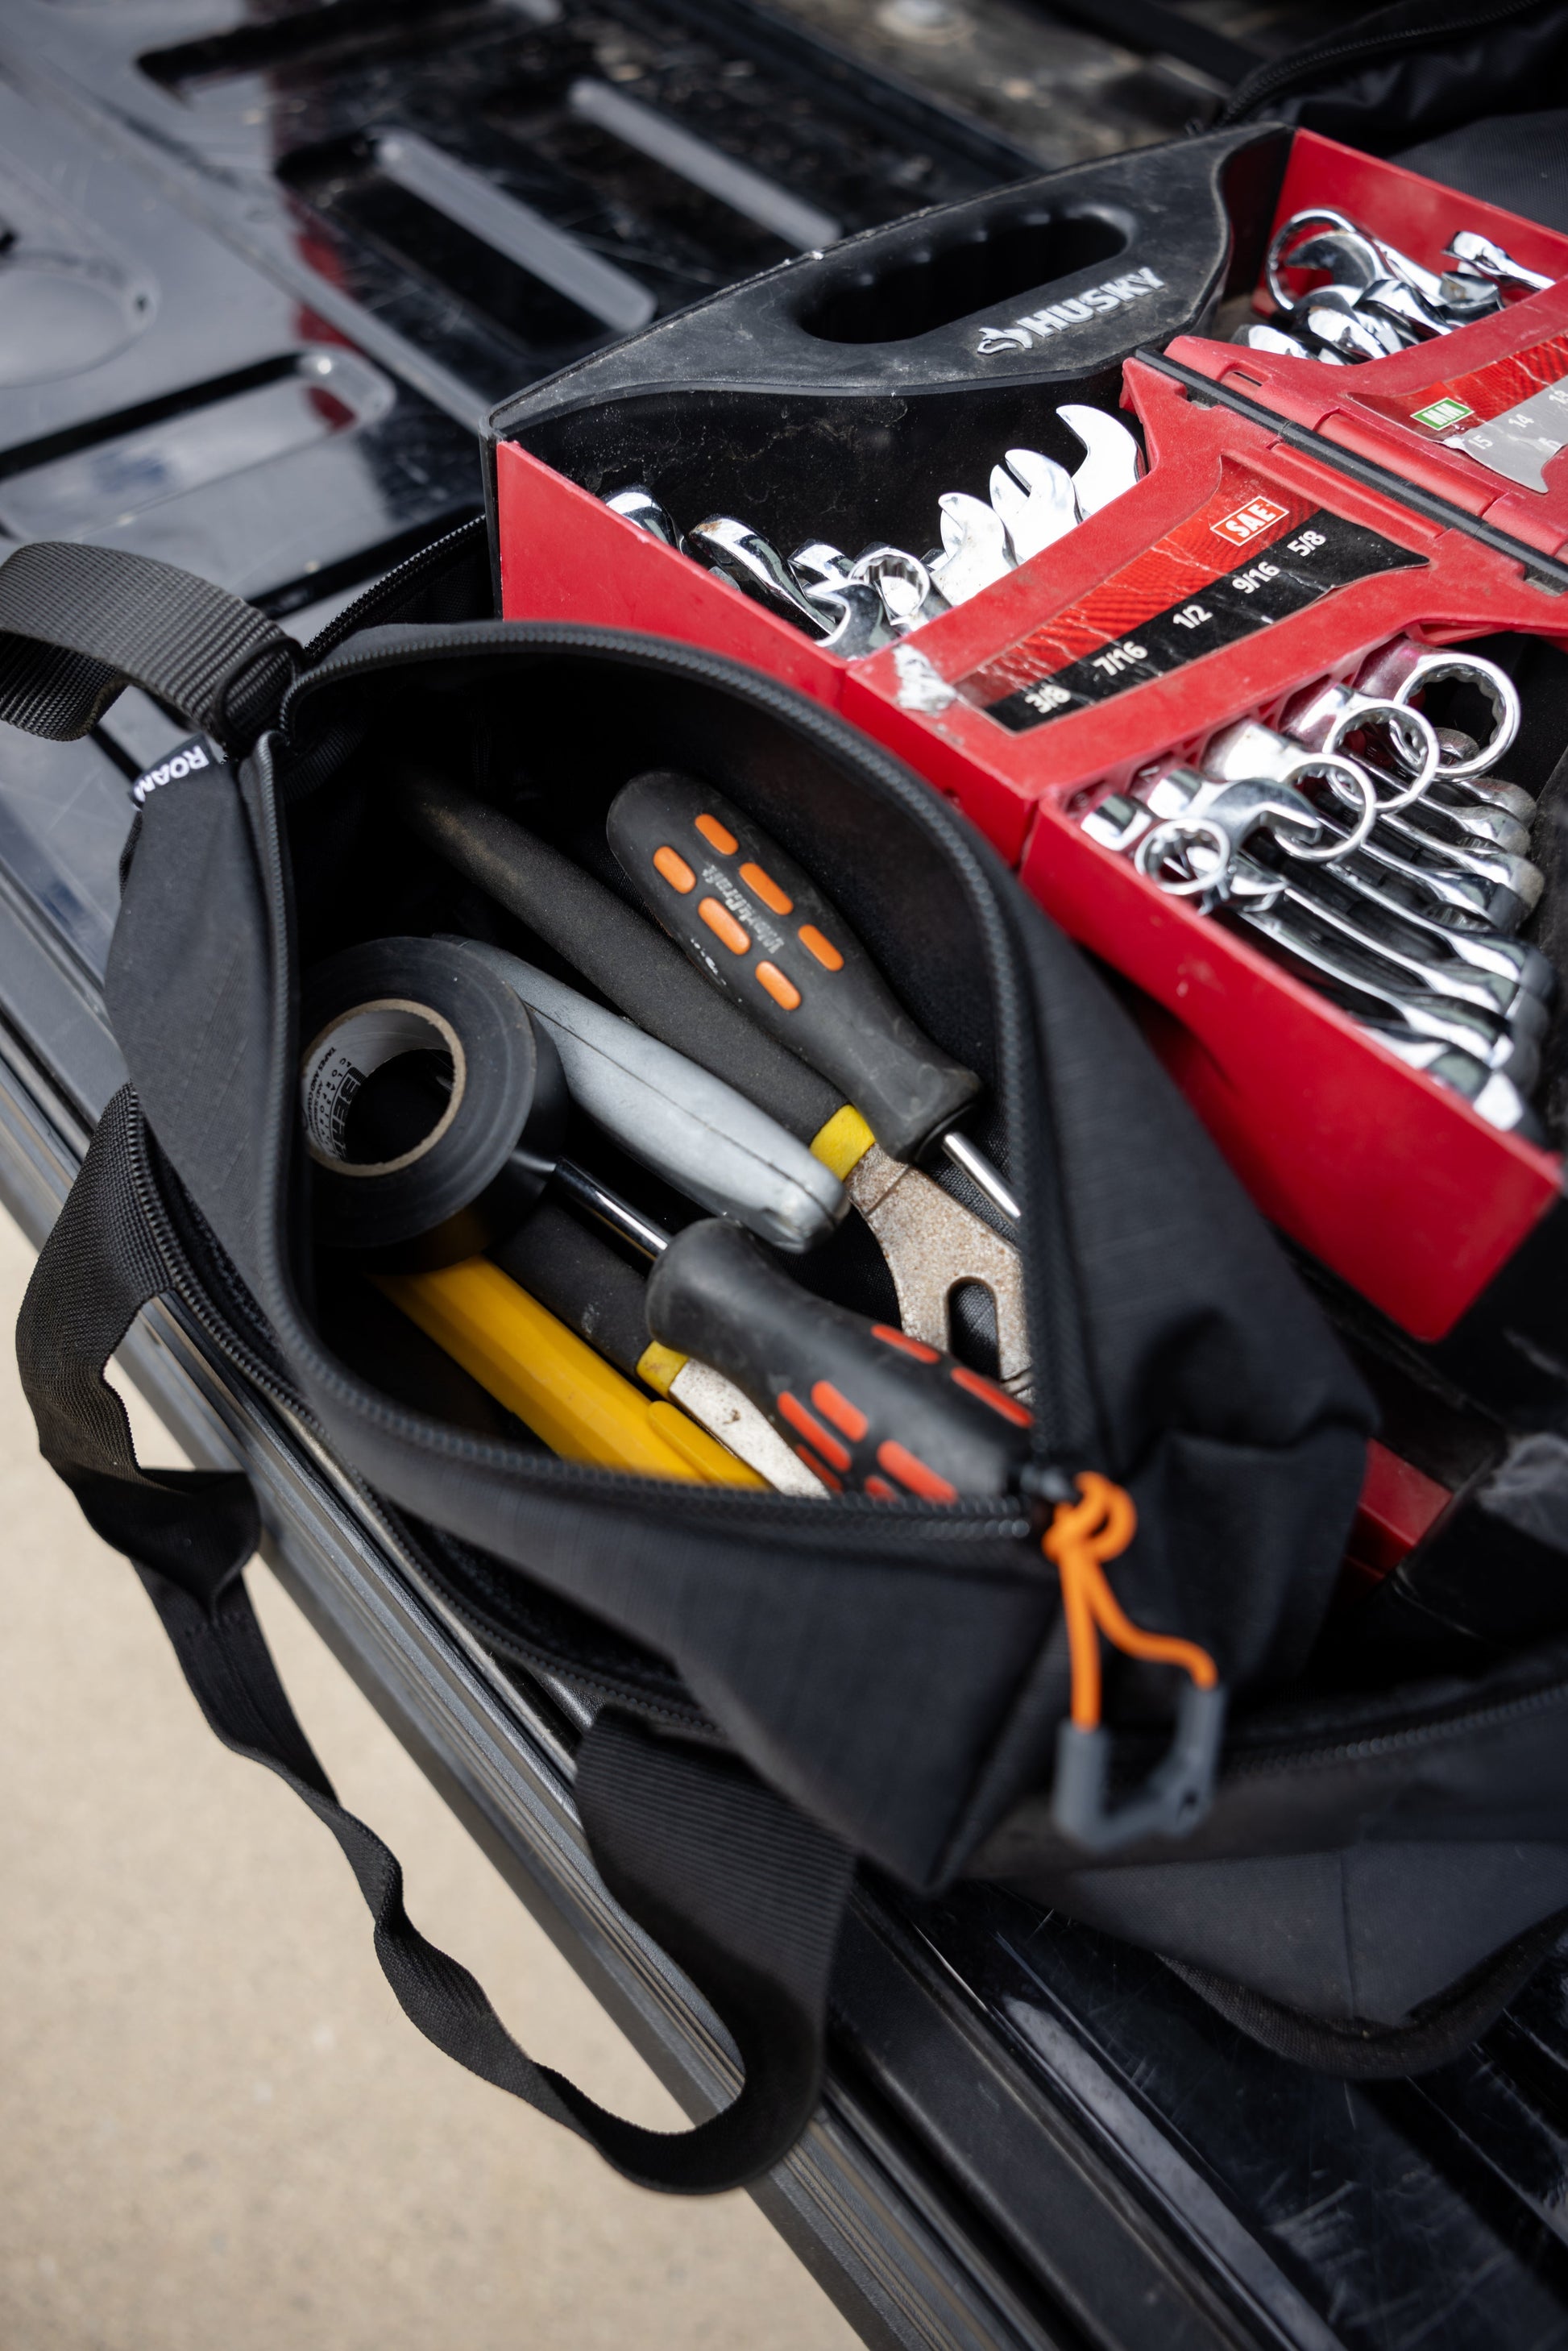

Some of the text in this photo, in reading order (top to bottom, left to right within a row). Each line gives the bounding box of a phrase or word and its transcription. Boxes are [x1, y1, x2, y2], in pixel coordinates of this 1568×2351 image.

[1017, 267, 1165, 338] HUSKY
[1421, 402, 1466, 426] MM
[1467, 434, 1493, 450] 15
[1508, 413, 1535, 428] 14
[1225, 504, 1277, 538] SAE
[1024, 530, 1326, 714] 3/8 7/16 1/2 9/16 5/8
